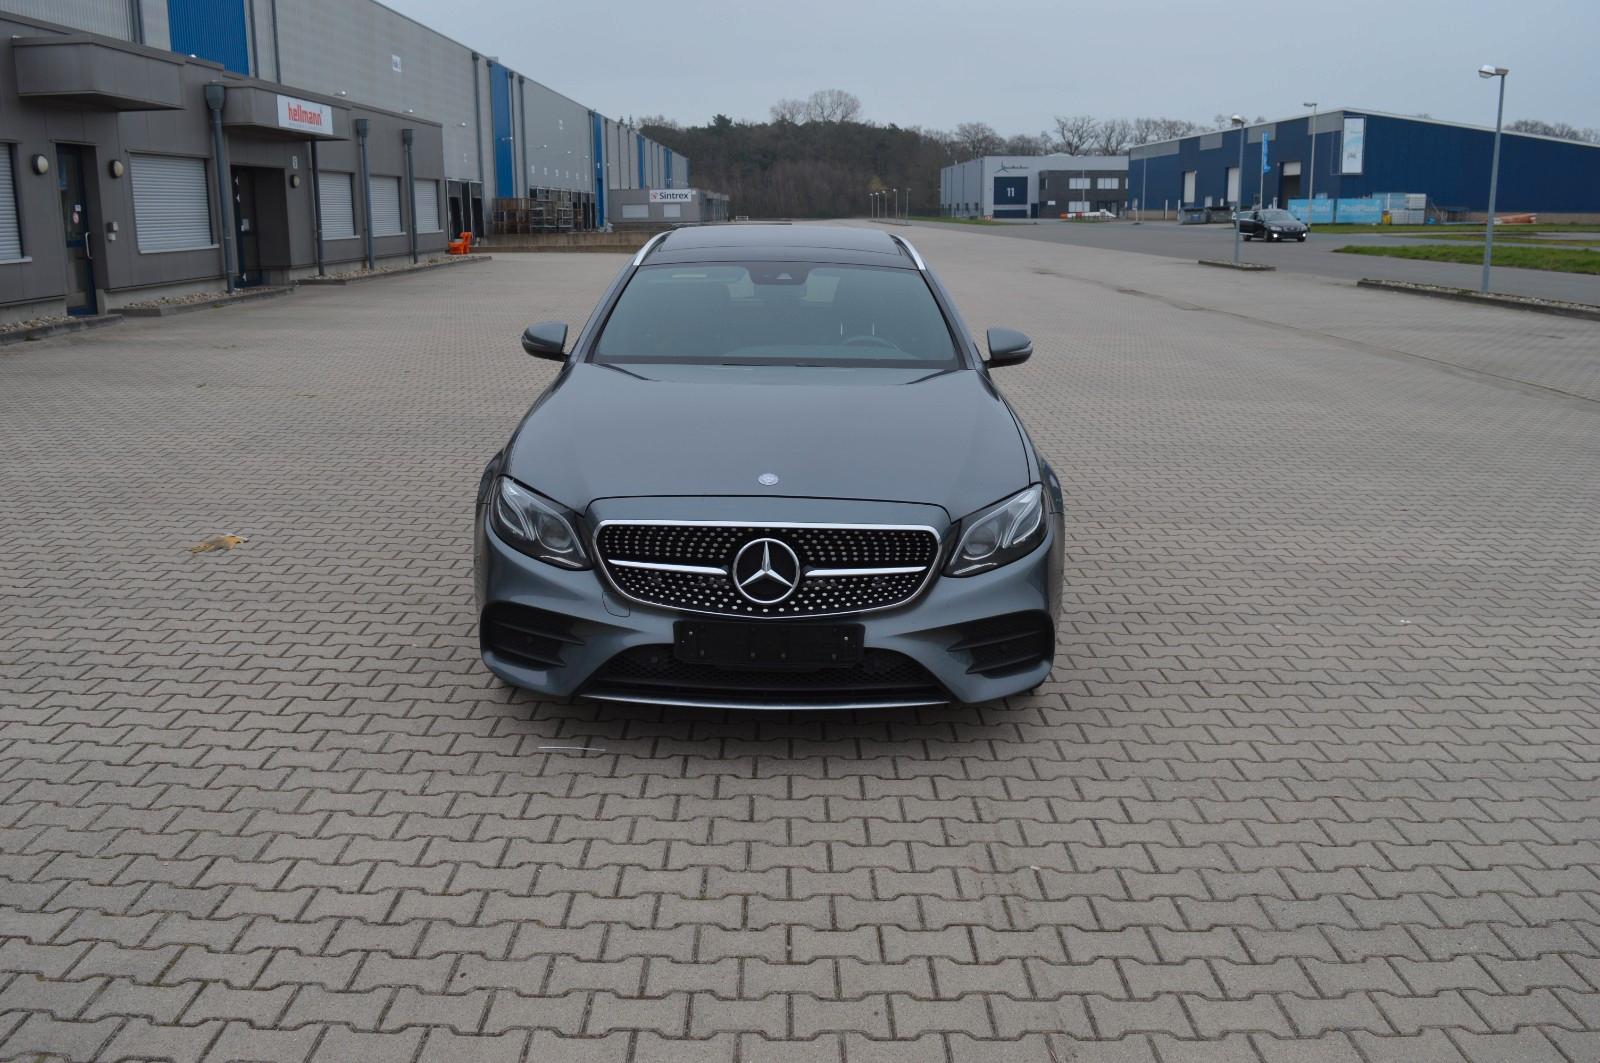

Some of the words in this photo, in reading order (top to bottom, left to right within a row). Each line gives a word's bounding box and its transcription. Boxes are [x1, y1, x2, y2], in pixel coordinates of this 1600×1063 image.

[287, 102, 322, 126] hellmann
[659, 191, 689, 200] Sintrex
[1006, 187, 1015, 197] 11
